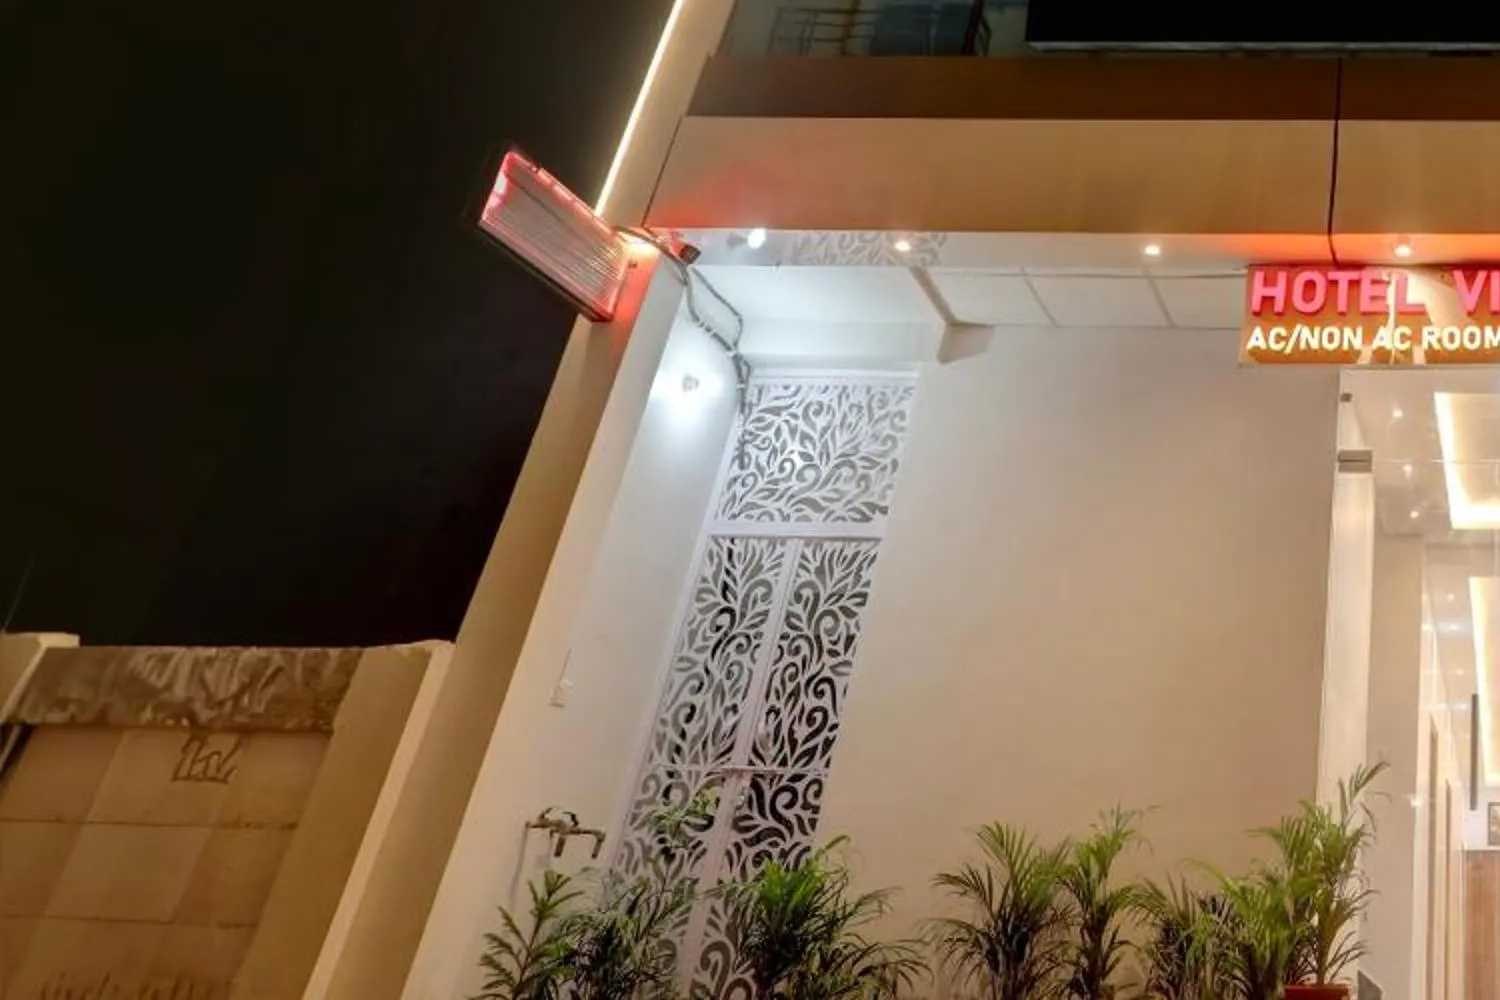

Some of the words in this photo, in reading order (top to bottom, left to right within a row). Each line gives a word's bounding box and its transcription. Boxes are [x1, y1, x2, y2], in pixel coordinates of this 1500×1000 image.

[1251, 269, 1427, 317] HOTEL
[1246, 325, 1364, 354] AC/NON
[1371, 325, 1413, 351] AC
